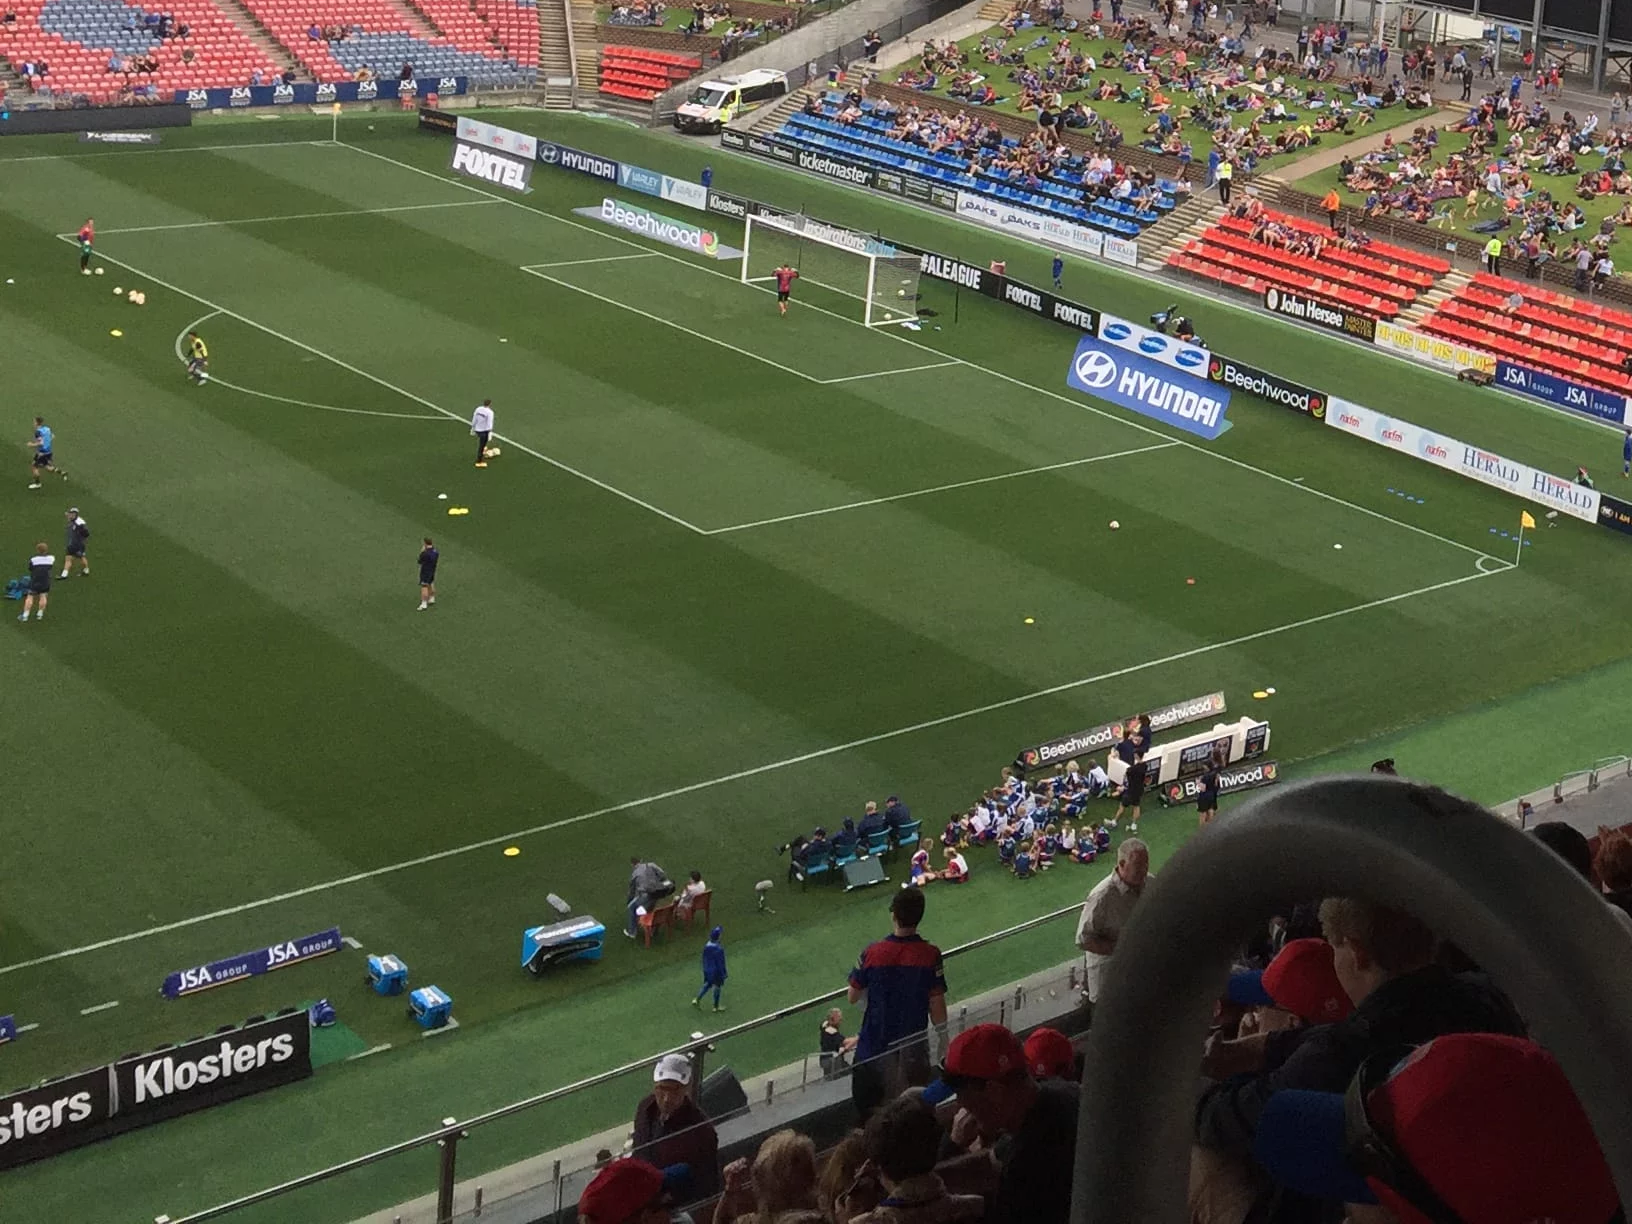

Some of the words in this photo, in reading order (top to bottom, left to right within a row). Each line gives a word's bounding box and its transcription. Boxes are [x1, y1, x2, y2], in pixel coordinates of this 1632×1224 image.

[185, 90, 207, 101] JSA
[230, 87, 251, 98] JSA
[273, 85, 295, 97] JSA
[316, 83, 337, 95] JSA
[357, 81, 378, 93] JSA
[398, 79, 418, 91] JSA
[438, 77, 457, 88] JSA
[452, 143, 526, 191] FOXTEL
[562, 150, 615, 180] HYUNDAI
[799, 151, 869, 184] ticketmaster
[709, 194, 745, 217] Klosters
[602, 197, 701, 248] Beechwood
[920, 253, 982, 291] #ALEAGUE
[1005, 283, 1043, 312] FOXTEL
[1278, 292, 1306, 318] John
[1306, 299, 1343, 327] Hersee
[1054, 302, 1093, 330] FOXTEL
[1224, 365, 1310, 412] Beechwood
[1503, 367, 1527, 388] JSA
[1117, 367, 1222, 427] HYUNDAI
[1564, 387, 1588, 408] JSA
[1425, 444, 1447, 460] nxfm
[1462, 447, 1520, 484] HERALD
[1532, 473, 1592, 510] HERALD
[1618, 513, 1630, 524] AM
[1040, 727, 1113, 761] Beechwood
[1185, 766, 1263, 796] Behwood
[267, 941, 299, 966] JSA
[302, 939, 334, 955] GROUP
[178, 966, 212, 991] JSA
[215, 963, 248, 980] GROUP
[133, 1031, 294, 1104] Klosters
